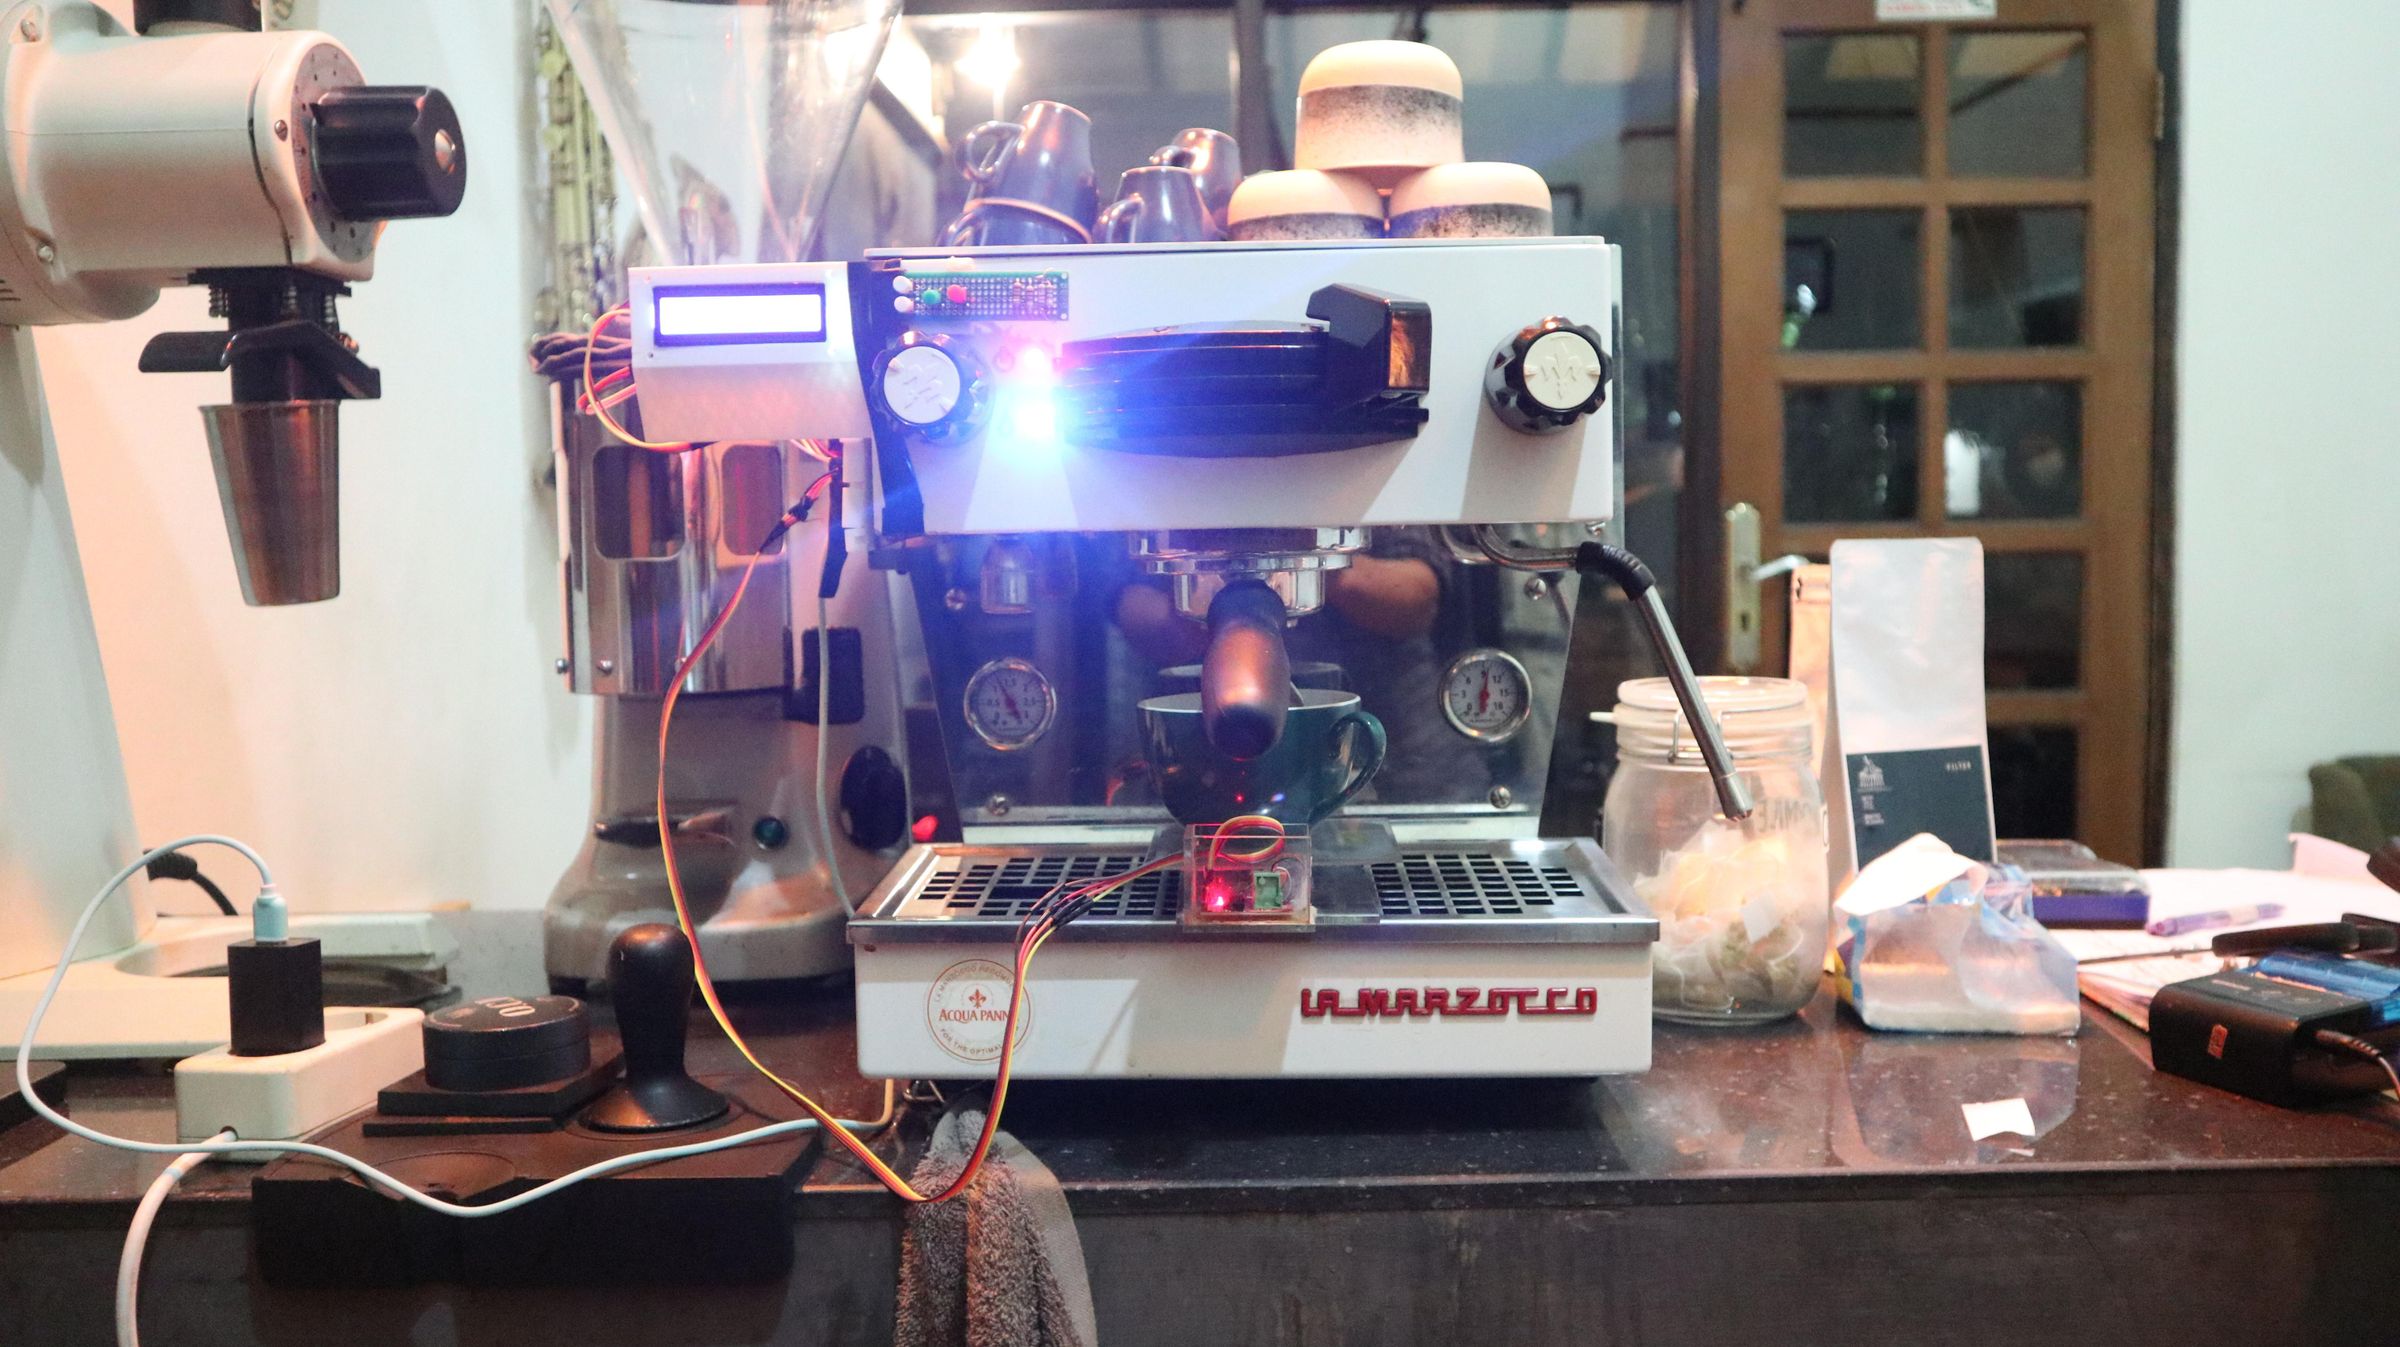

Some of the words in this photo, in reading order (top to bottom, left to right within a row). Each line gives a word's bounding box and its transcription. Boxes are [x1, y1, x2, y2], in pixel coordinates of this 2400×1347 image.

[1301, 988, 1339, 1017] LA
[1357, 988, 1597, 1017] MARZOCCO
[939, 1008, 978, 1024] ACQUA
[980, 1009, 1010, 1021] PANN
[940, 1028, 953, 1043] FOR
[953, 1041, 968, 1053] THE
